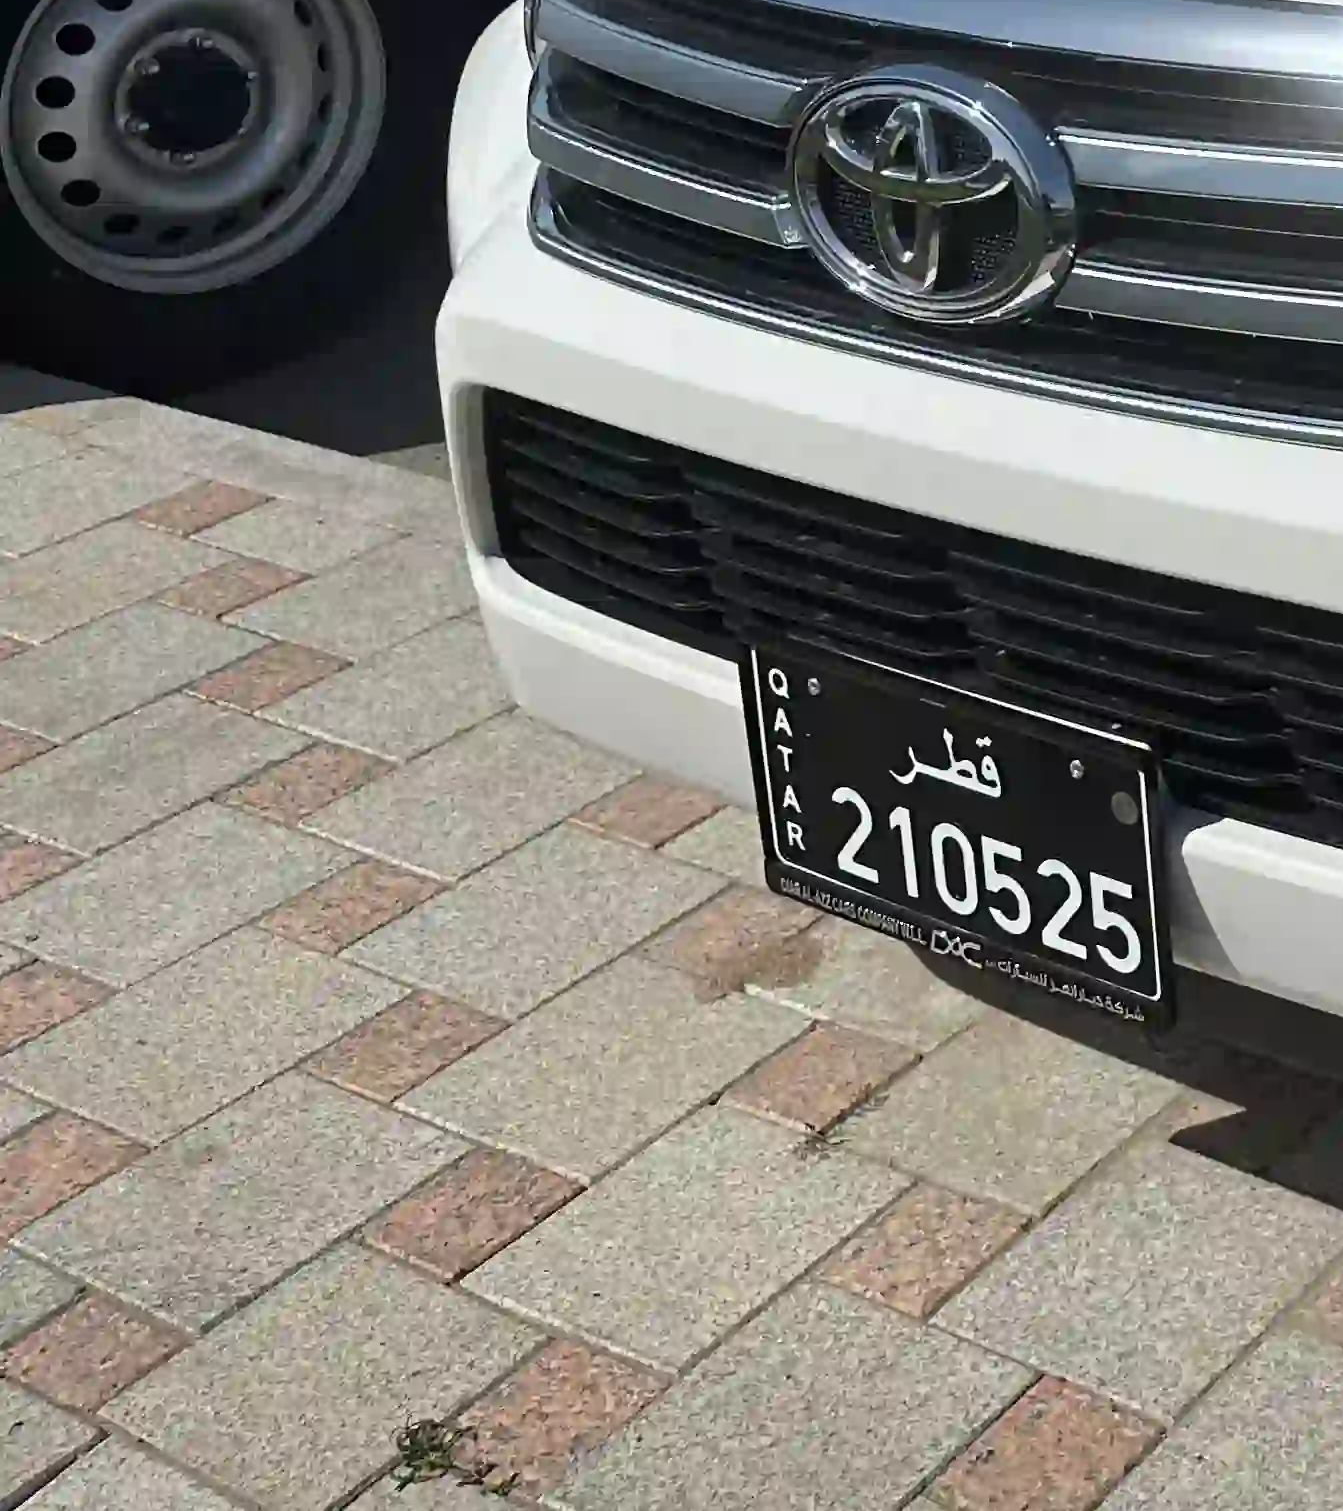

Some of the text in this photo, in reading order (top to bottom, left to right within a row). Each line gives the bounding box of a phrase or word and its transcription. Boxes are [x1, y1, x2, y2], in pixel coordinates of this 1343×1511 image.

[767, 667, 806, 852] QATAR
[889, 728, 1002, 798] قطر
[831, 786, 1142, 974] 210525
